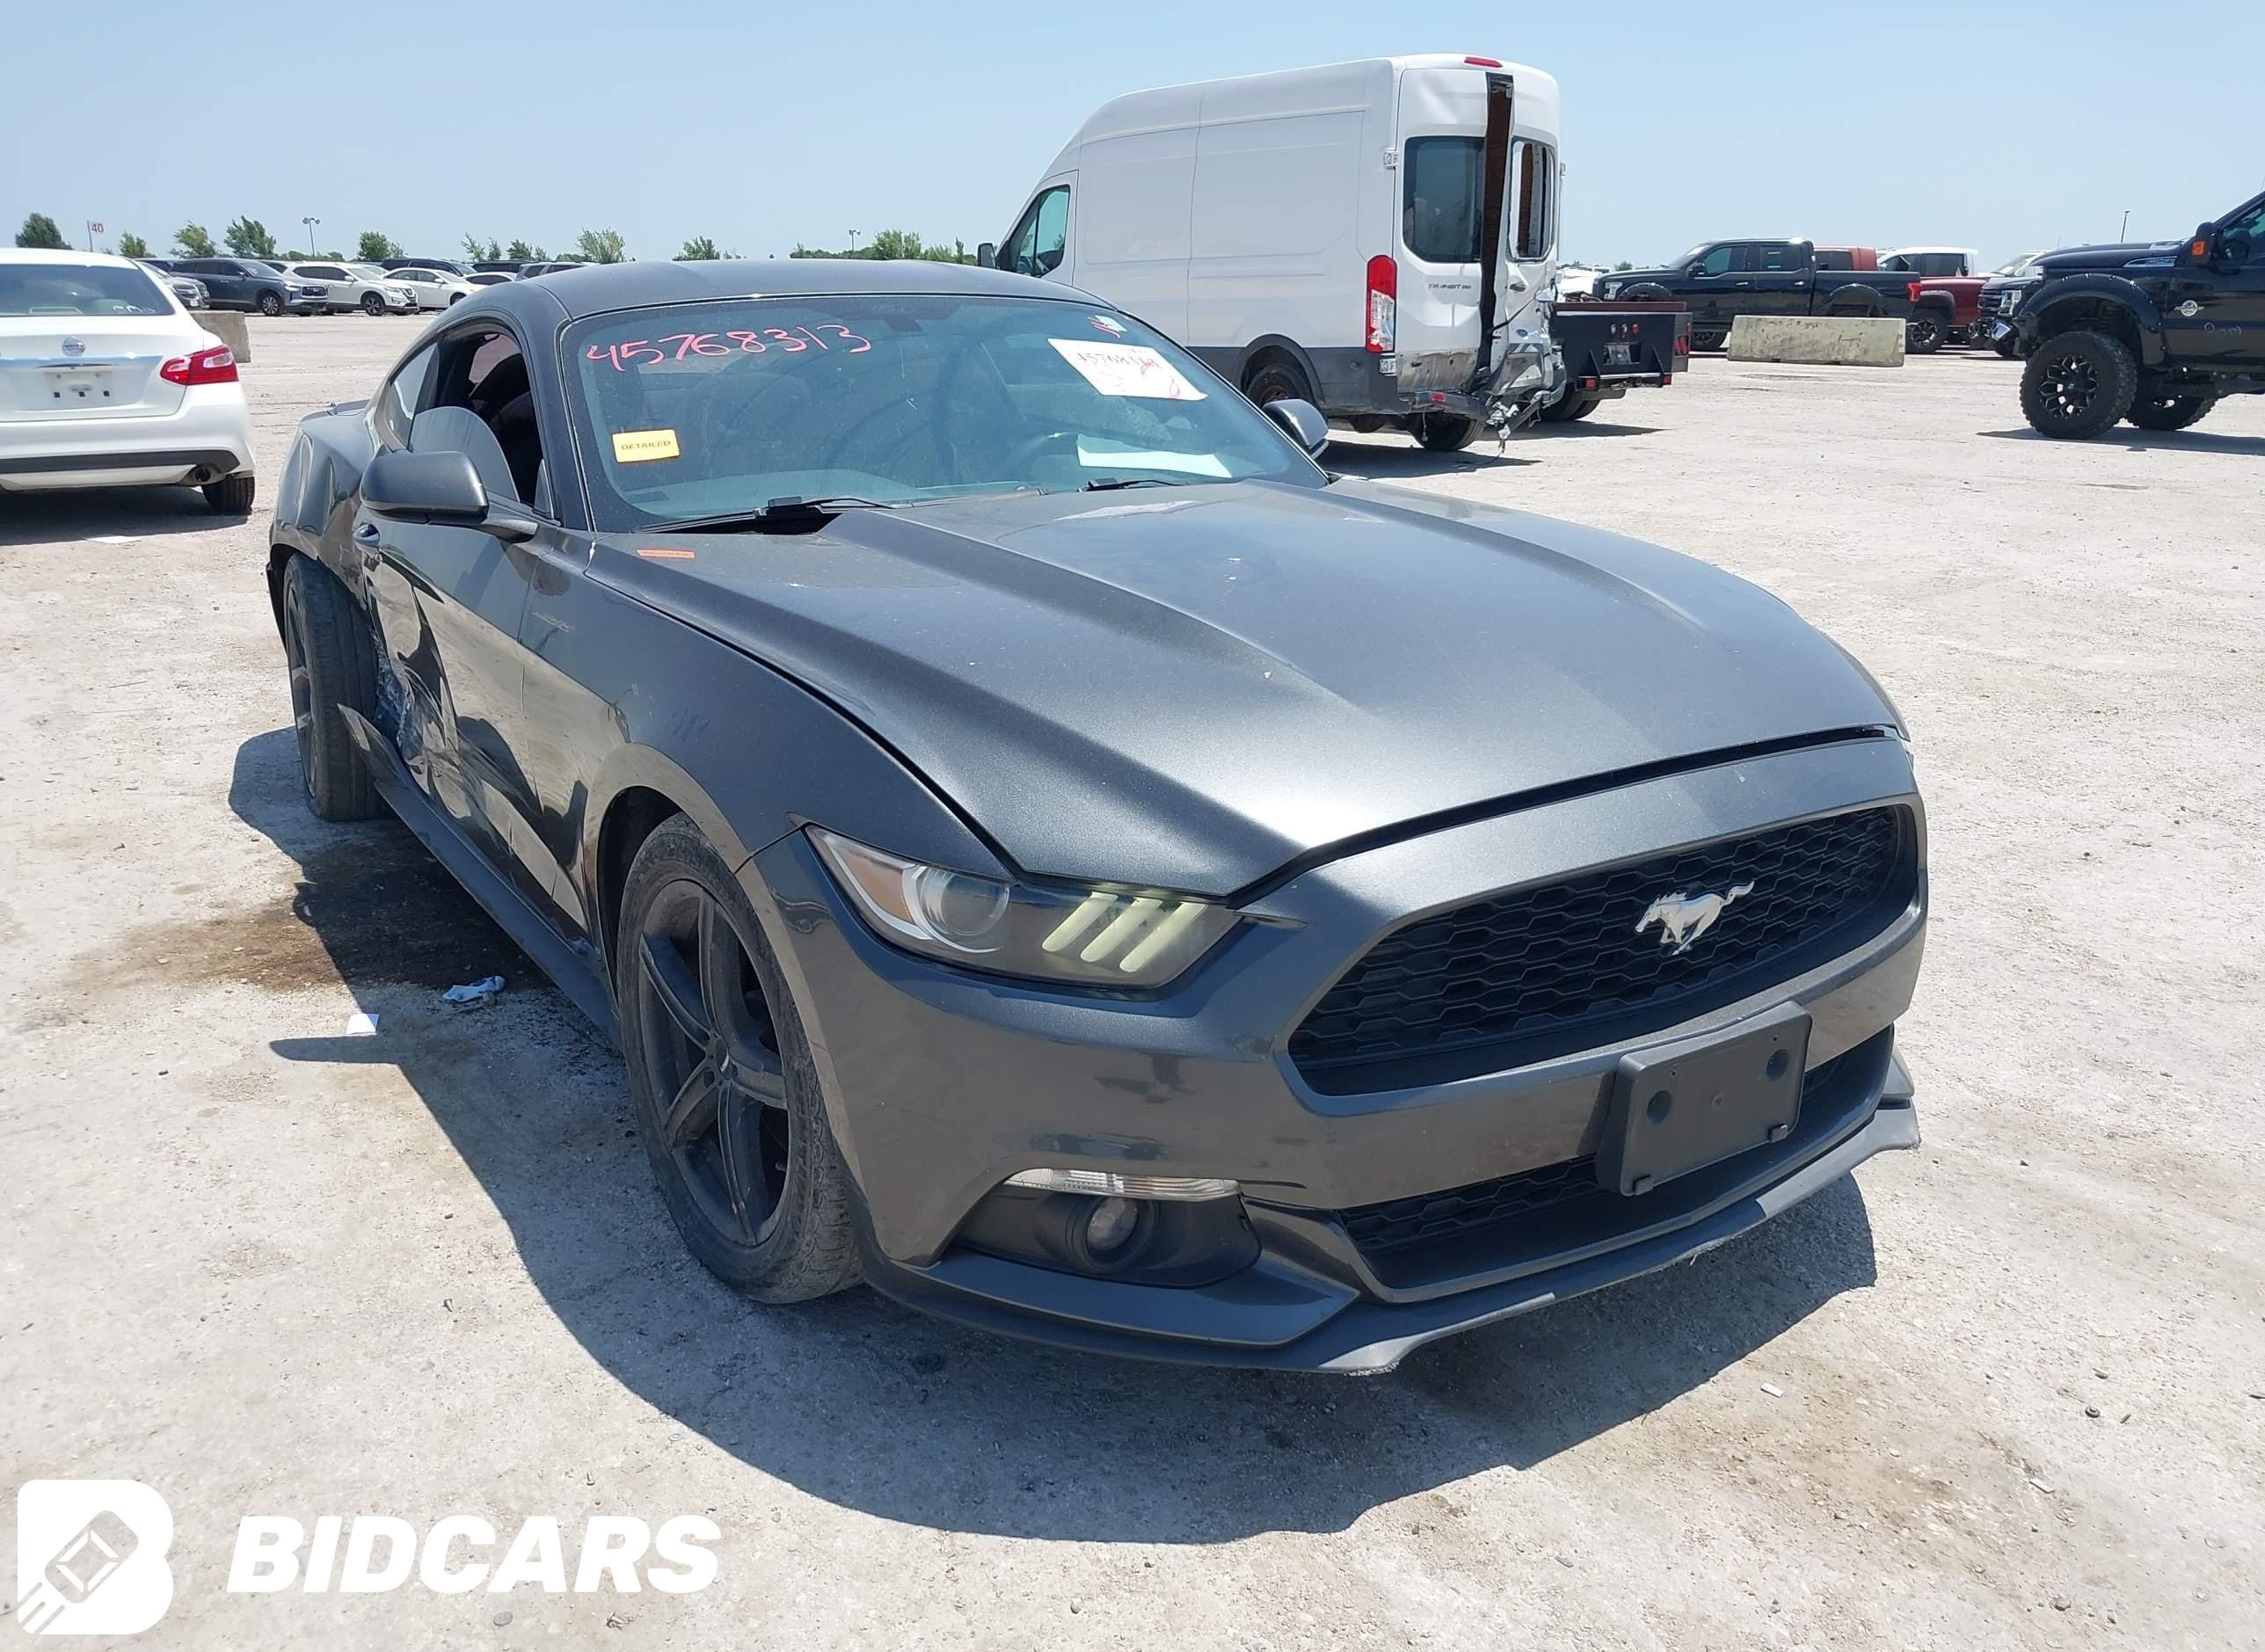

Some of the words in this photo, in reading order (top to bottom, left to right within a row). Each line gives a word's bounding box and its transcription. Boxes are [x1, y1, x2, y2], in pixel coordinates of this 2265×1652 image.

[91, 223, 104, 233] 40
[586, 324, 871, 372] 45768313
[621, 440, 671, 450] DETAILED
